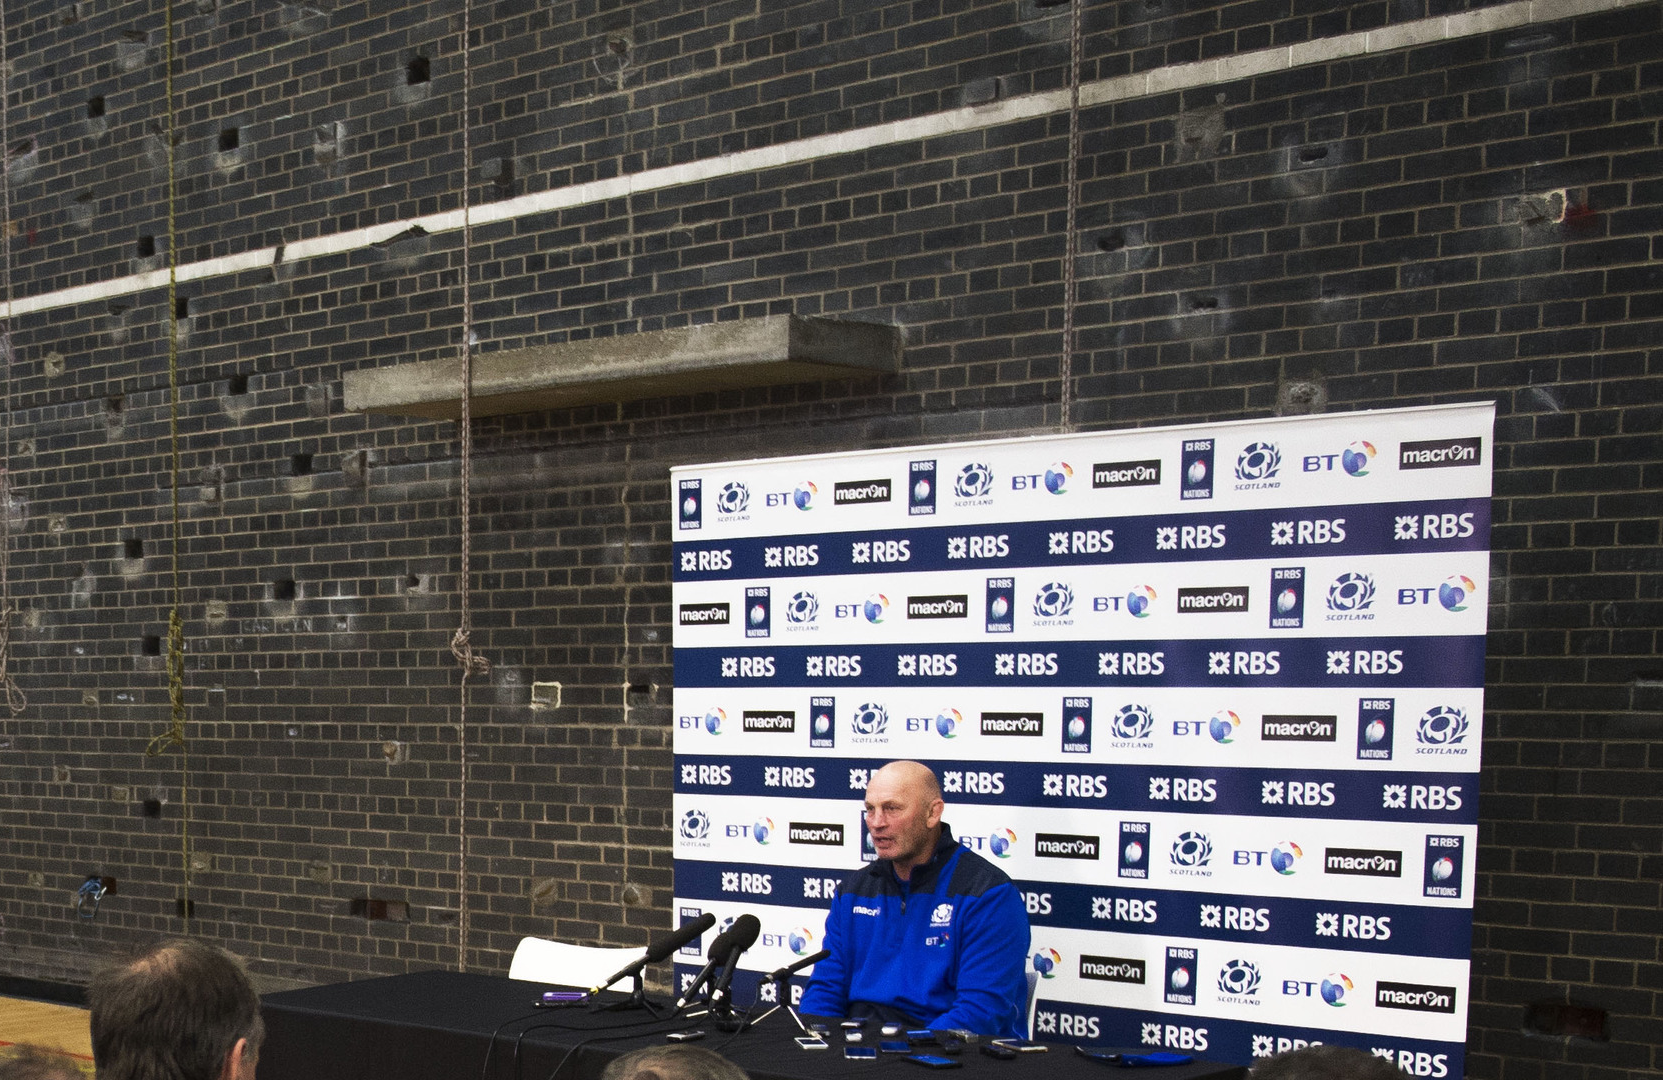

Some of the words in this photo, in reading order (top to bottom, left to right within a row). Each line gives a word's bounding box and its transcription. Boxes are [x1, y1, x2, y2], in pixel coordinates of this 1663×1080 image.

[1403, 444, 1475, 464] macron
[1303, 454, 1339, 472] BT
[1012, 474, 1042, 490] BT
[1095, 466, 1156, 483] macron
[836, 485, 888, 500] macron
[1183, 489, 1210, 499] NATIONS
[1234, 482, 1281, 491] SCOTLAND
[766, 492, 791, 507] BT
[910, 506, 934, 514] NATIONS
[1297, 518, 1346, 544] RBS
[1423, 513, 1474, 539] RBS
[1072, 530, 1114, 554] RBS
[1181, 524, 1226, 549] RBS
[873, 540, 911, 563] RBS
[969, 535, 1010, 558] RBS
[699, 549, 732, 571] RBS
[784, 545, 819, 567] RBS
[1093, 596, 1124, 612] BT
[1180, 592, 1245, 608] macron
[1398, 588, 1436, 605] BT
[680, 607, 727, 622] macron
[835, 604, 862, 618] BT
[909, 599, 963, 615] macron
[988, 623, 1011, 631] NATIONS
[1272, 618, 1300, 627] NATIONS
[747, 629, 769, 637] NATIONS
[740, 656, 775, 677] RBS
[825, 655, 862, 677] RBS
[919, 654, 957, 676] RBS
[1017, 653, 1058, 676] RBS
[1123, 652, 1165, 676] RBS
[1234, 651, 1281, 675] RBS
[1354, 650, 1404, 674] RBS
[679, 716, 703, 729] BT
[745, 714, 793, 729] macron
[906, 717, 934, 732] BT
[982, 717, 1039, 732] macron
[1173, 721, 1207, 736] BT
[1264, 721, 1332, 736] macron
[811, 739, 833, 747] NATIONS
[1064, 743, 1088, 753] NATIONS
[1415, 747, 1468, 755] SCOTLAND
[1360, 749, 1389, 759] NATIONS
[699, 765, 731, 785] RBS
[782, 767, 815, 788] RBS
[965, 771, 1004, 794] RBS
[1066, 774, 1108, 798] RBS
[1173, 778, 1217, 802] RBS
[1287, 782, 1336, 806] RBS
[1410, 785, 1462, 811] RBS
[725, 825, 751, 838] BT
[790, 827, 841, 842] macron
[959, 836, 988, 851] BT
[1037, 840, 1095, 855] macron
[1233, 850, 1268, 866] BT
[1328, 855, 1396, 872] macron
[1120, 868, 1146, 878] NATIONS
[1169, 868, 1212, 877] SCOTLAND
[741, 873, 772, 895] RBS
[1427, 886, 1457, 897] NATIONS
[1019, 891, 1052, 915] BS
[1115, 898, 1157, 923] RBS
[1224, 906, 1270, 932] RBS
[1342, 914, 1391, 940] RBS
[762, 934, 786, 948] BT
[925, 937, 939, 946] BT
[1082, 961, 1141, 979] macron
[1282, 980, 1318, 997] BT
[1166, 993, 1193, 1004] NATIONS
[1216, 995, 1261, 1006] SCOTLAND
[1379, 988, 1450, 1007] macron
[1060, 1013, 1100, 1038] RBS
[1165, 1025, 1208, 1051] RBS
[1398, 1050, 1448, 1078] RBS
